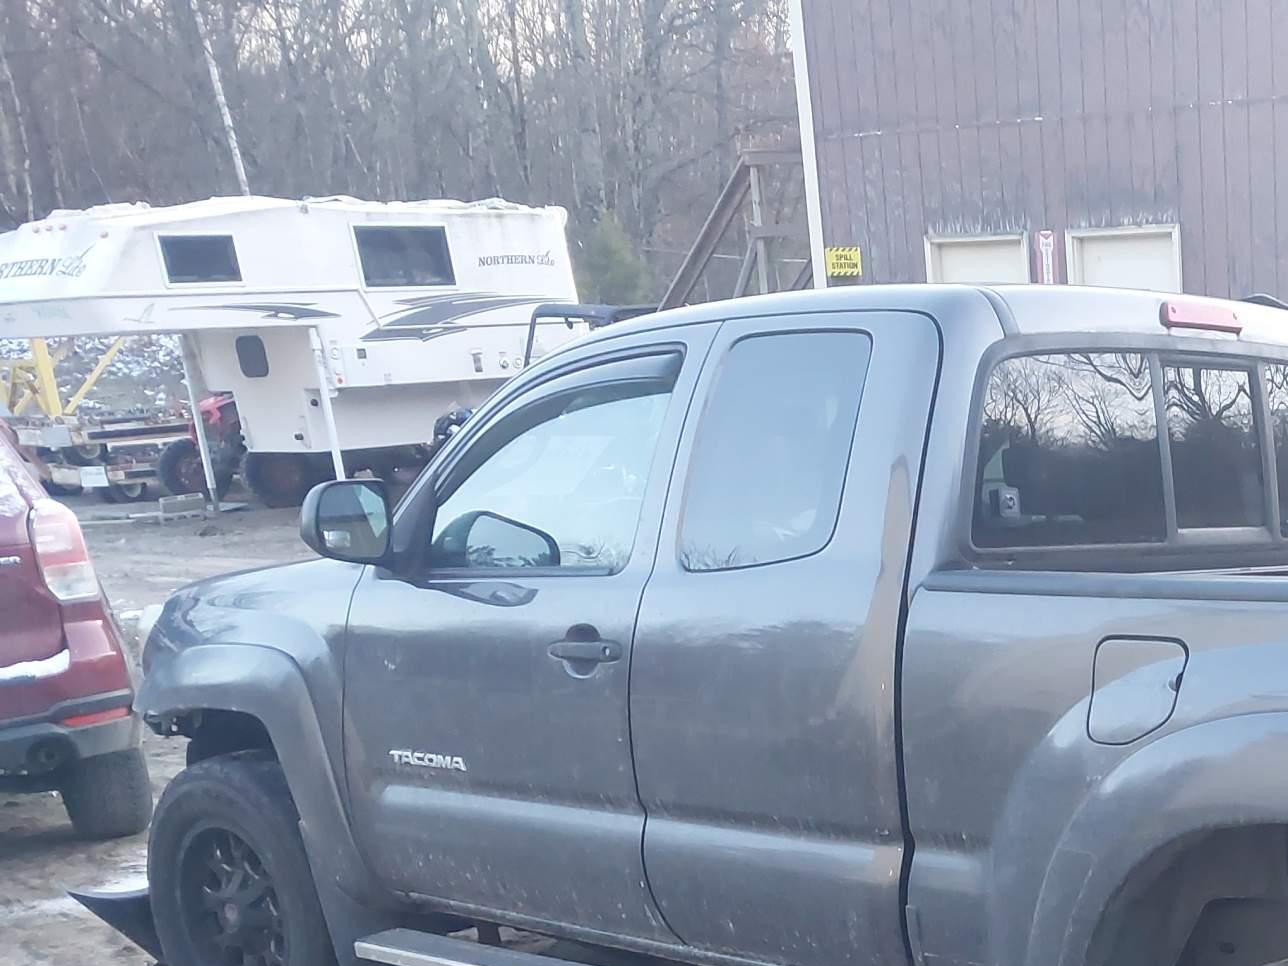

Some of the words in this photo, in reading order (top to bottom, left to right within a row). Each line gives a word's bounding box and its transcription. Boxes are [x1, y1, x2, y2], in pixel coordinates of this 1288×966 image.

[478, 255, 535, 267] NORTHERN
[835, 253, 853, 261] SPILL
[831, 262, 858, 270] STATION
[389, 749, 467, 771] TACOMA
